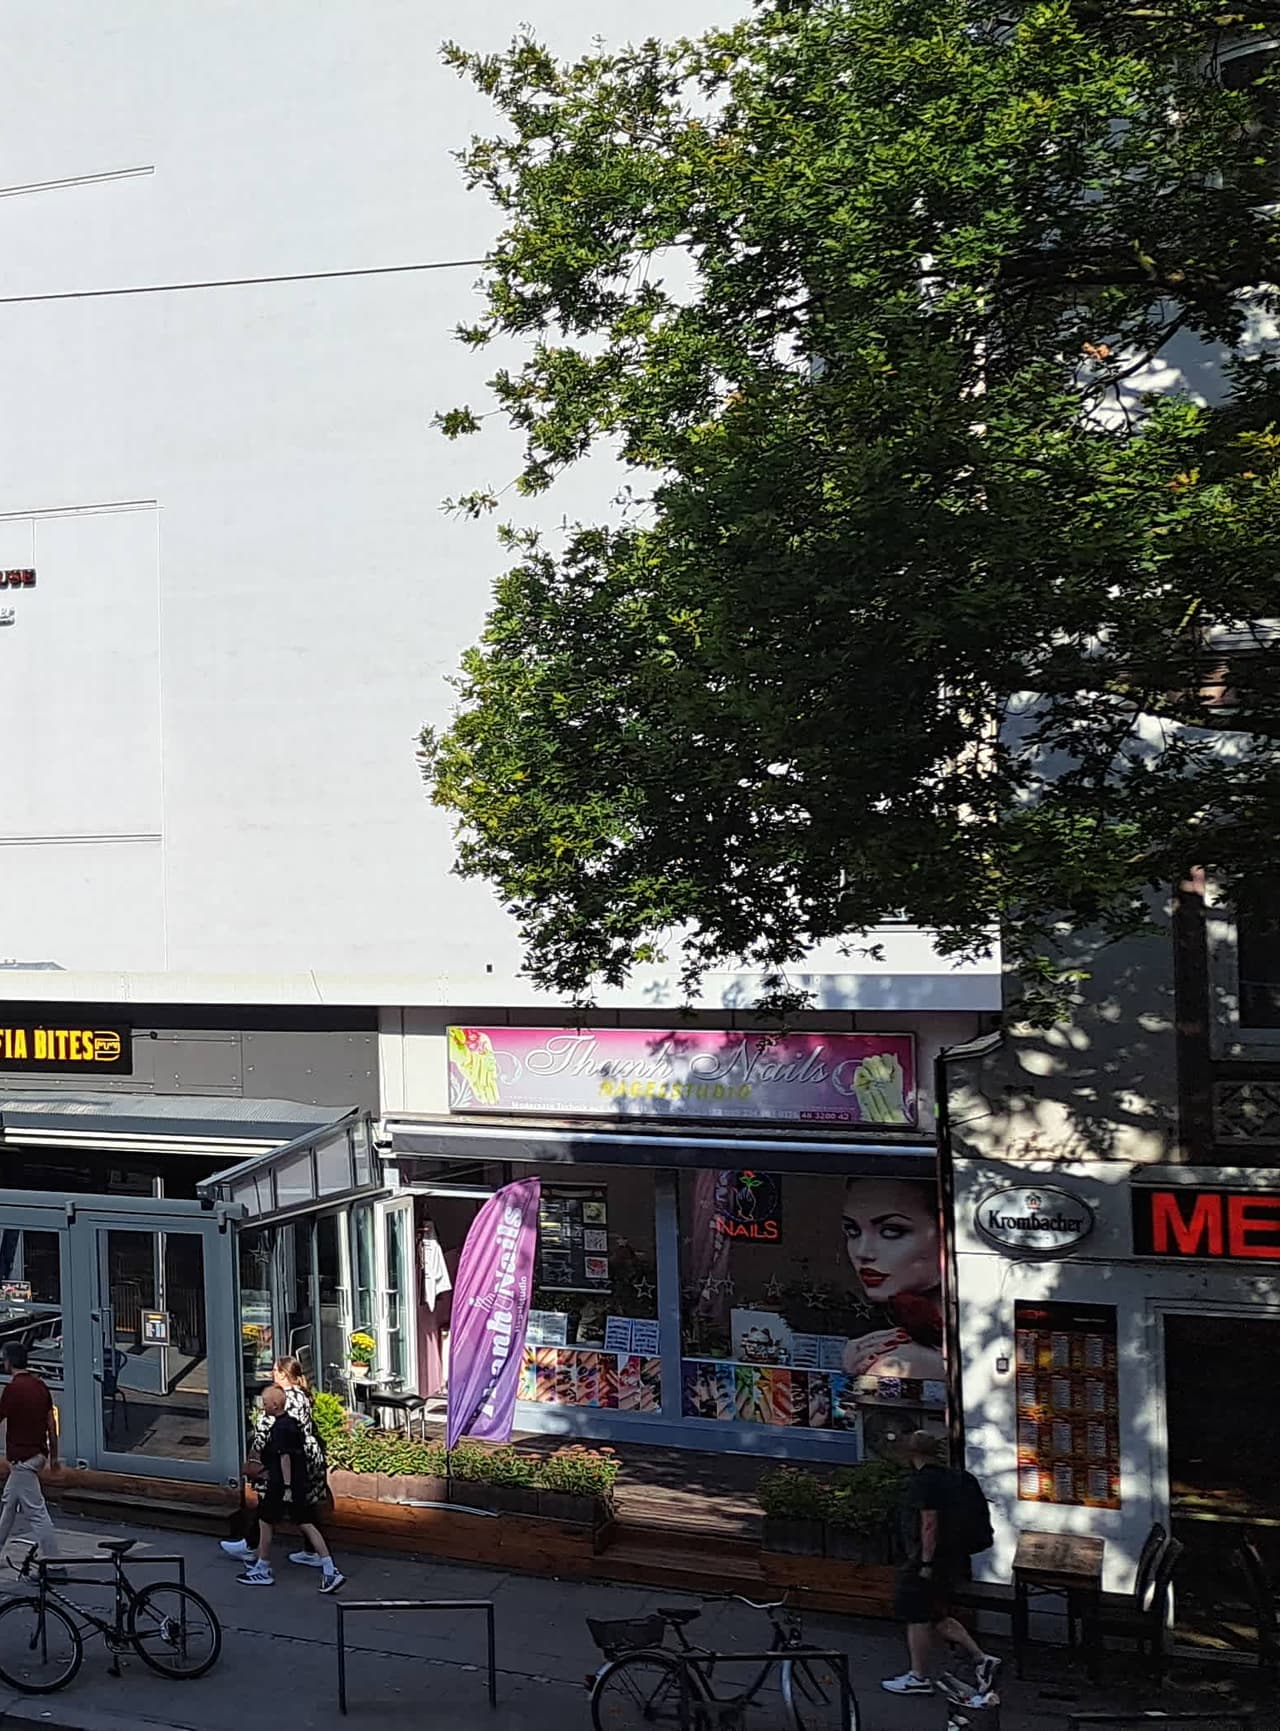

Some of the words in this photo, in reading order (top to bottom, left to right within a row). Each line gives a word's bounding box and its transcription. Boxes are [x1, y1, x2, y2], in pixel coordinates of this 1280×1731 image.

[34, 1028, 94, 1061] BITES
[690, 1039, 830, 1083] Nails
[716, 1216, 778, 1239] NAILS
[989, 1210, 1083, 1233] Krombacher
